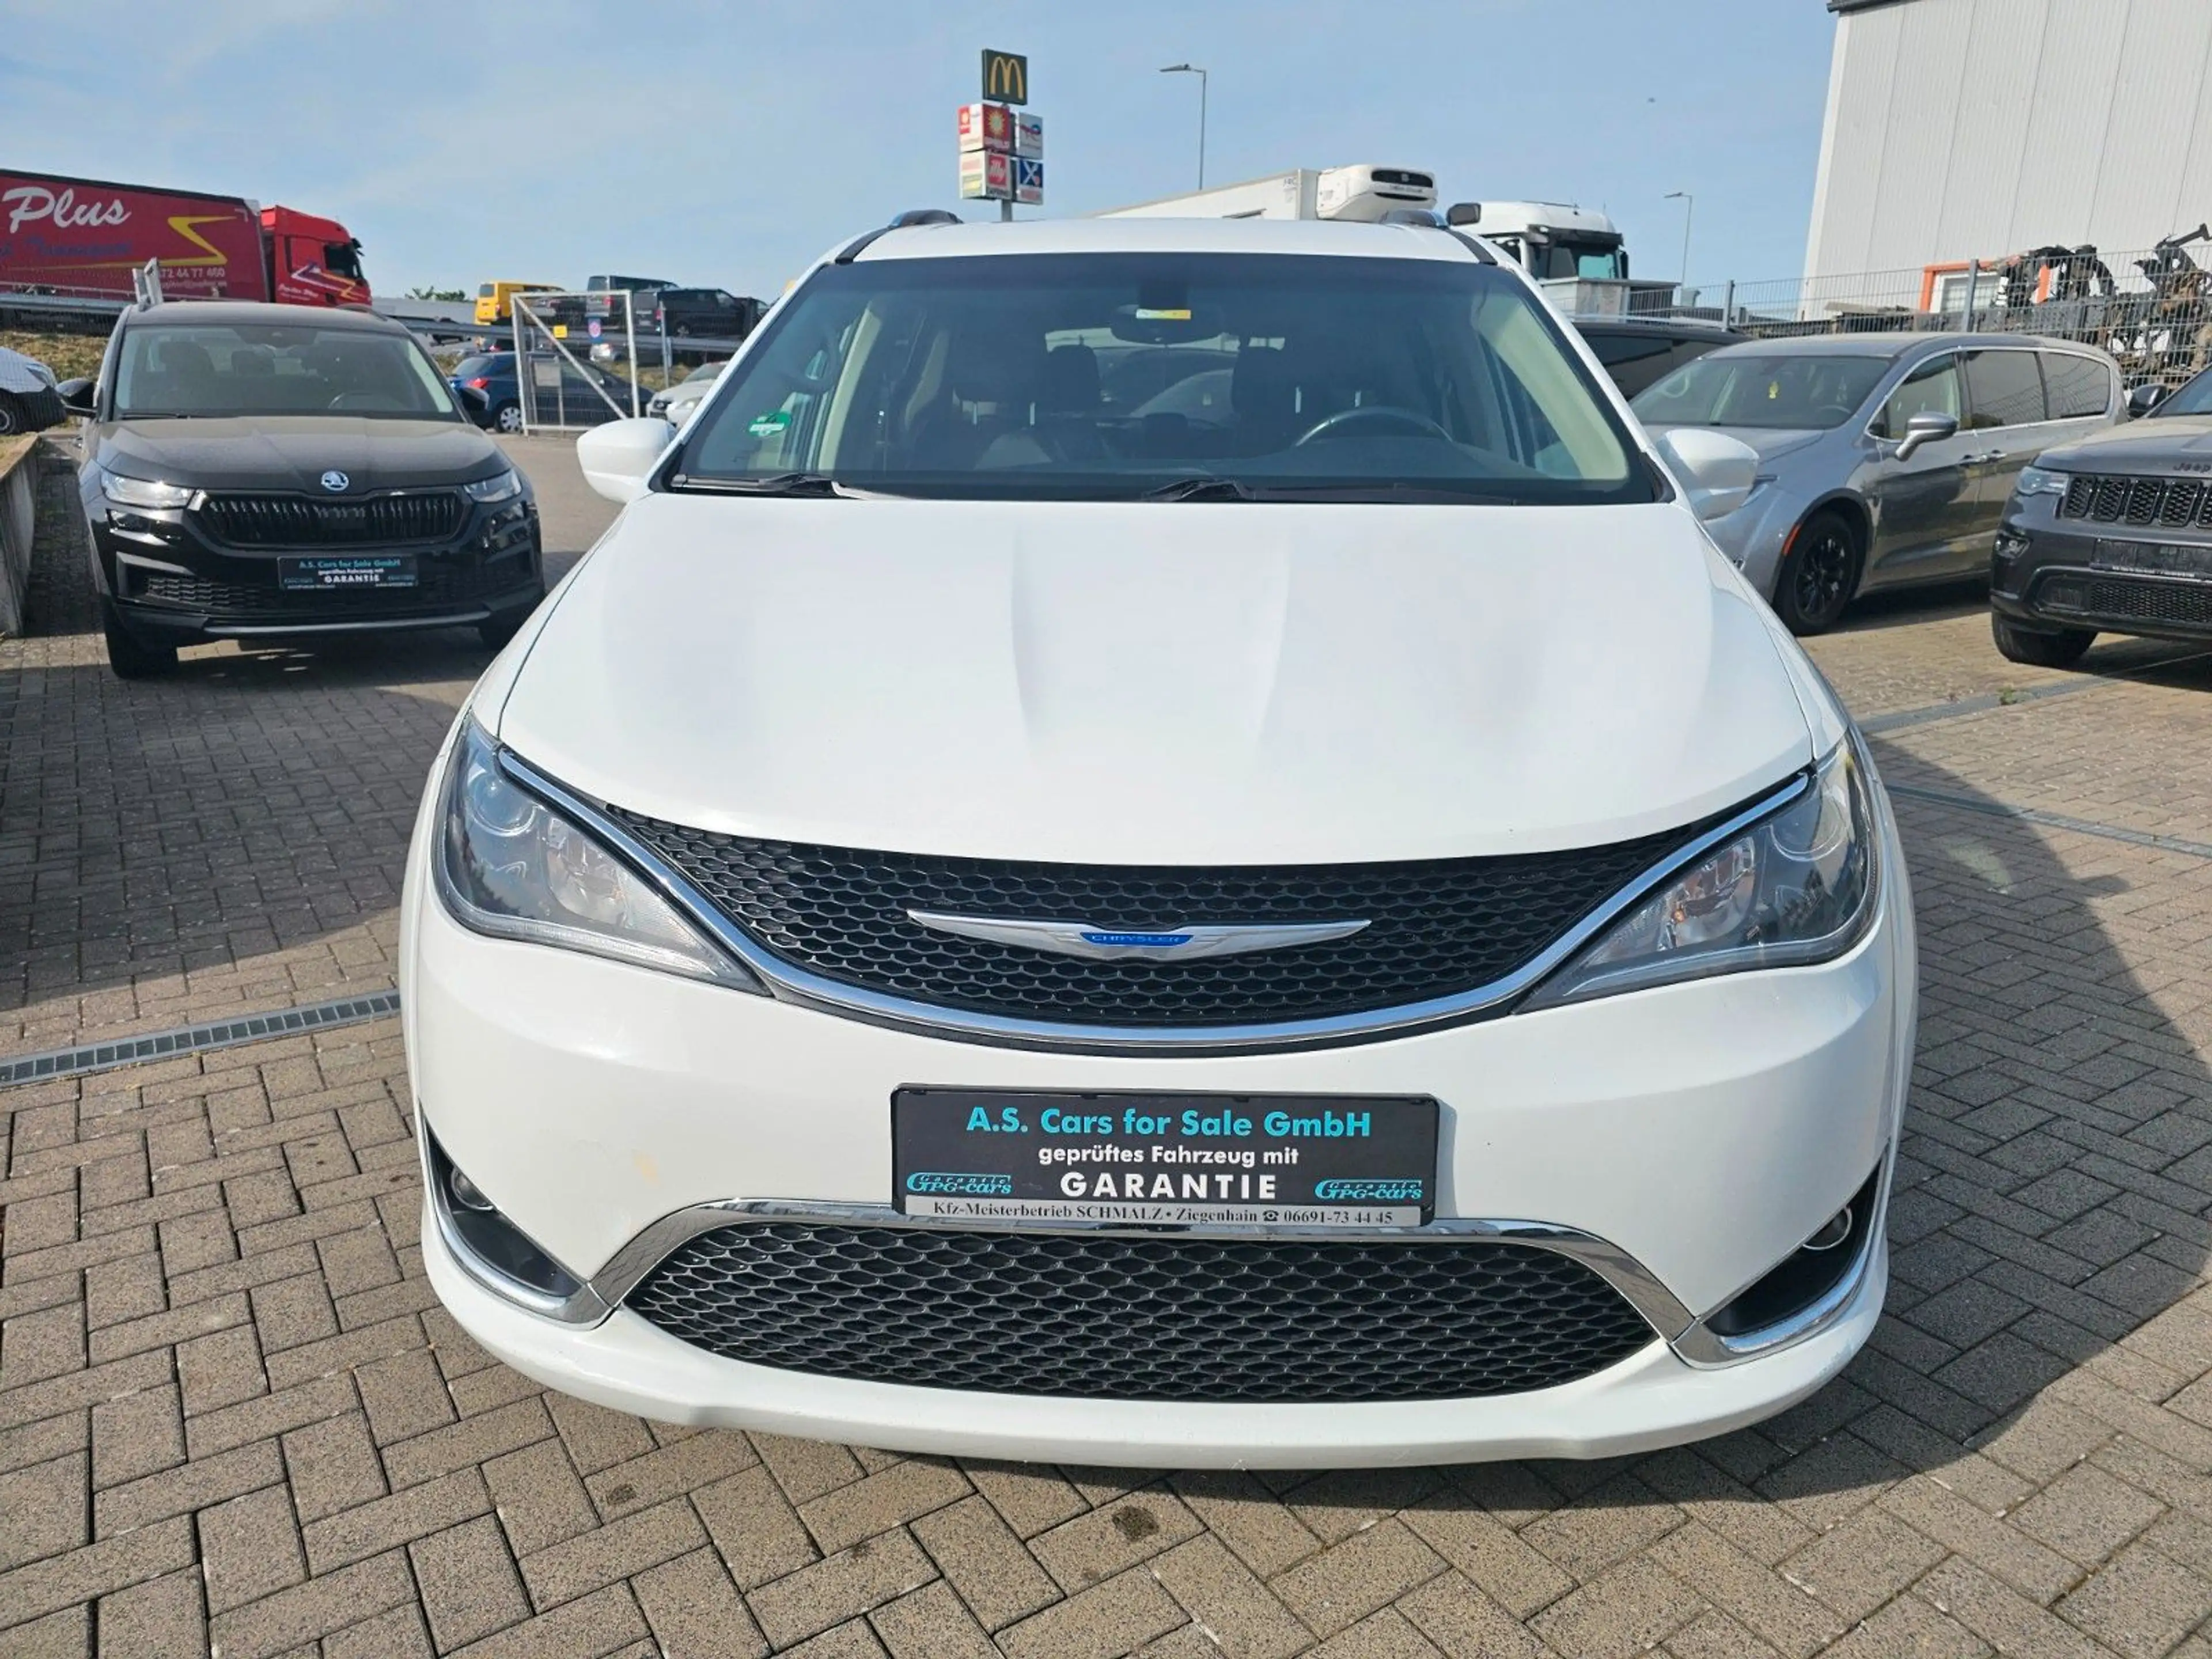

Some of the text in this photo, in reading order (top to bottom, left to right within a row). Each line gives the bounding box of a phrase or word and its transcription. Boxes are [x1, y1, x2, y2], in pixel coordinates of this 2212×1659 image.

[2, 186, 132, 234] Plus
[2173, 462, 2211, 474] Jeep
[324, 574, 380, 584] GARANTIE
[1092, 934, 1180, 942] CHRYSLER
[966, 1106, 1370, 1137] A.S. Cars for Sale GmbH
[1039, 1143, 1300, 1168] geprüftes Fahrzeug mit
[1060, 1171, 1277, 1200] GARANTIE
[934, 1201, 1393, 1225] Kfz-Meisterbetrieb SCHMALZ Ziegenhain 06691-73 44 45
